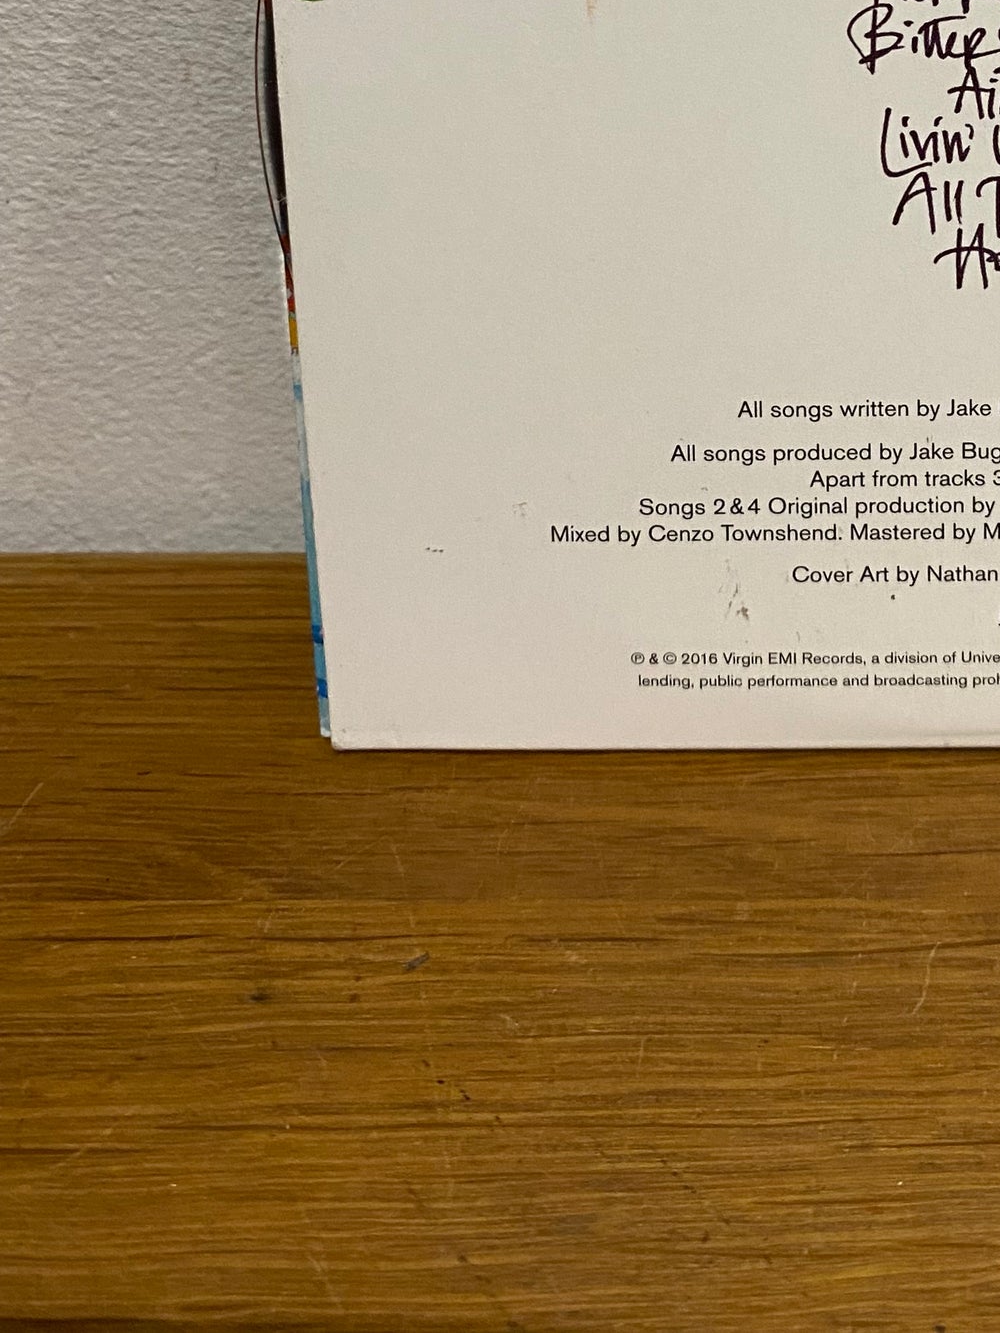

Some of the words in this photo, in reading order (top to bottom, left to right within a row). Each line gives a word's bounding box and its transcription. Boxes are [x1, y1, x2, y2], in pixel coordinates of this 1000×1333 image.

[892, 171, 964, 234] All
[737, 400, 763, 419] All
[770, 404, 834, 423] songs
[839, 398, 910, 418] written
[916, 398, 941, 422] by
[946, 398, 992, 417] Jake
[670, 443, 696, 463] All
[703, 448, 767, 467] songs
[773, 442, 872, 467] produced
[879, 442, 904, 466] by
[908, 441, 955, 461] Jake
[809, 469, 866, 493] Apart
[871, 469, 918, 488] from
[924, 468, 986, 488] tracks
[638, 497, 706, 521] Songs
[767, 495, 848, 520] Original
[855, 495, 965, 520] production
[972, 495, 996, 519] by
[550, 524, 610, 543] Mixed
[617, 524, 642, 548] by
[648, 524, 715, 543] Cenzo
[720, 522, 843, 542] Townshend.
[850, 522, 946, 541] Mastered
[952, 522, 977, 545] by
[791, 565, 854, 584] Cover
[859, 565, 890, 583] Art
[896, 564, 920, 588] by
[927, 564, 999, 583] Nathan
[680, 652, 718, 666] 2016
[722, 651, 763, 669] Virgin
[767, 651, 797, 666] EMI
[801, 651, 867, 667] Records,
[871, 654, 881, 665] a
[884, 650, 938, 665] division
[942, 650, 957, 665] of
[638, 673, 695, 691] lending,
[699, 674, 743, 691] public
[747, 674, 838, 691] performance
[842, 673, 870, 687] and
[873, 673, 968, 690] broadcasting
